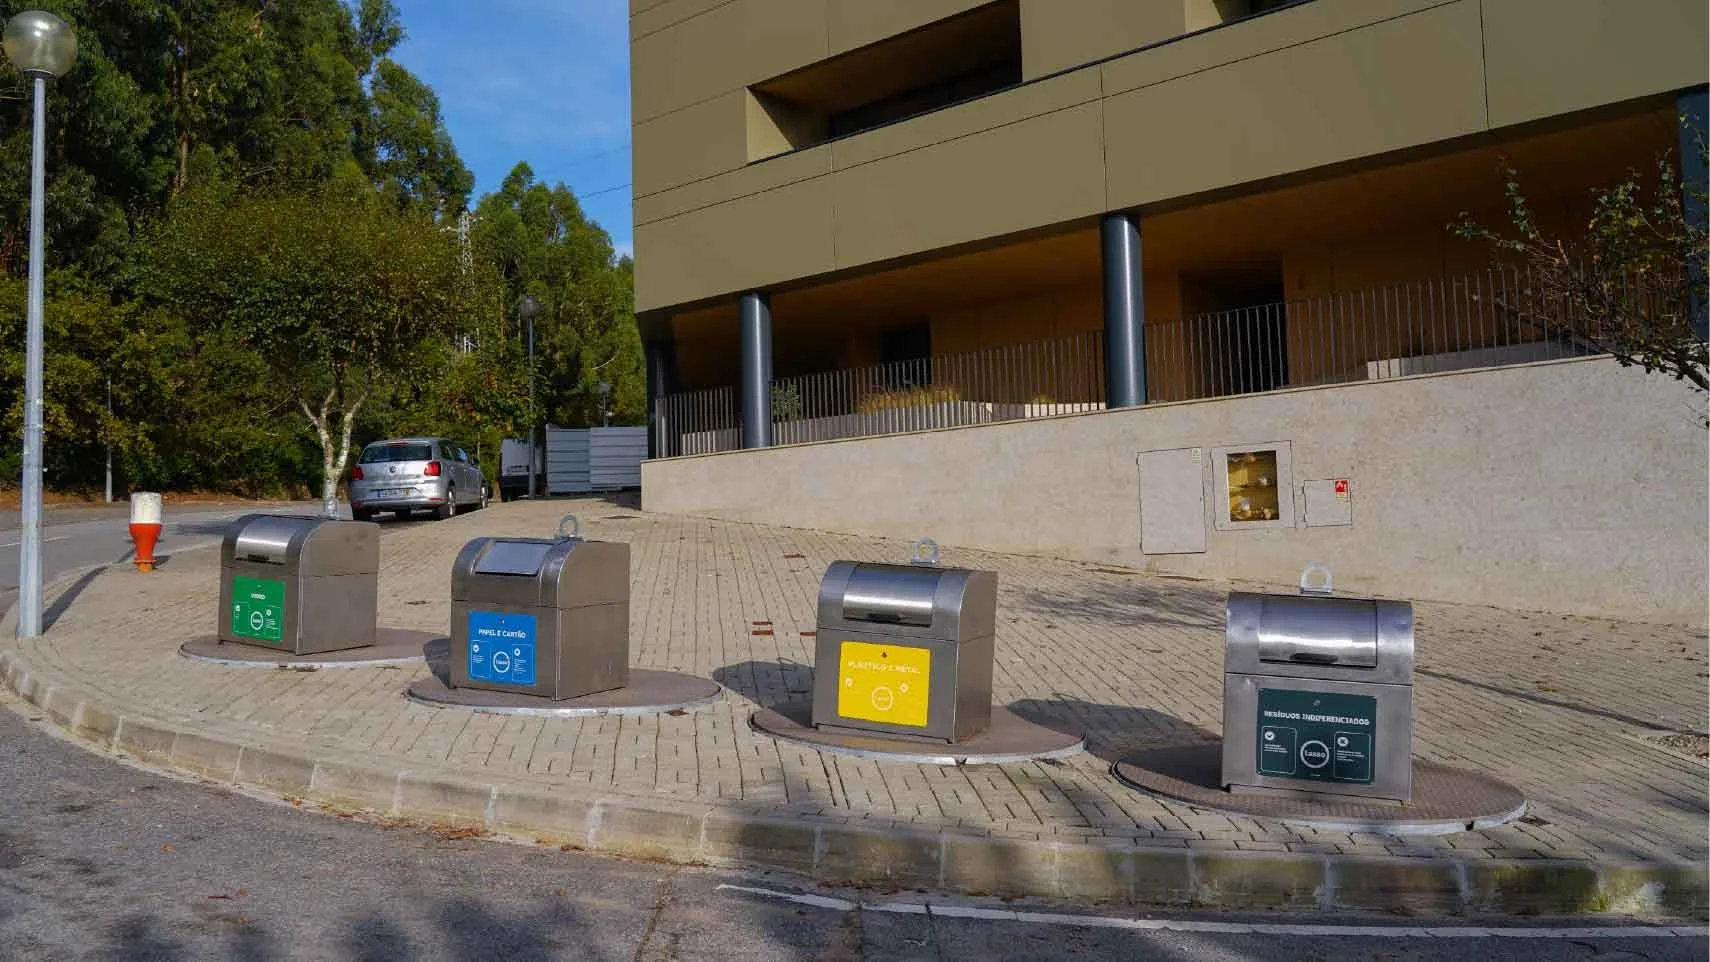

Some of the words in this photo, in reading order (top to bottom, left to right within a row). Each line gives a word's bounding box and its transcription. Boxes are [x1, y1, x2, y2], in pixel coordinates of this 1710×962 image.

[478, 628, 497, 637] PAPEL
[502, 629, 527, 639] CARTÃO
[1263, 709, 1301, 720] RESÍDUOS
[1302, 713, 1370, 726] INDIFERENCIADOS
